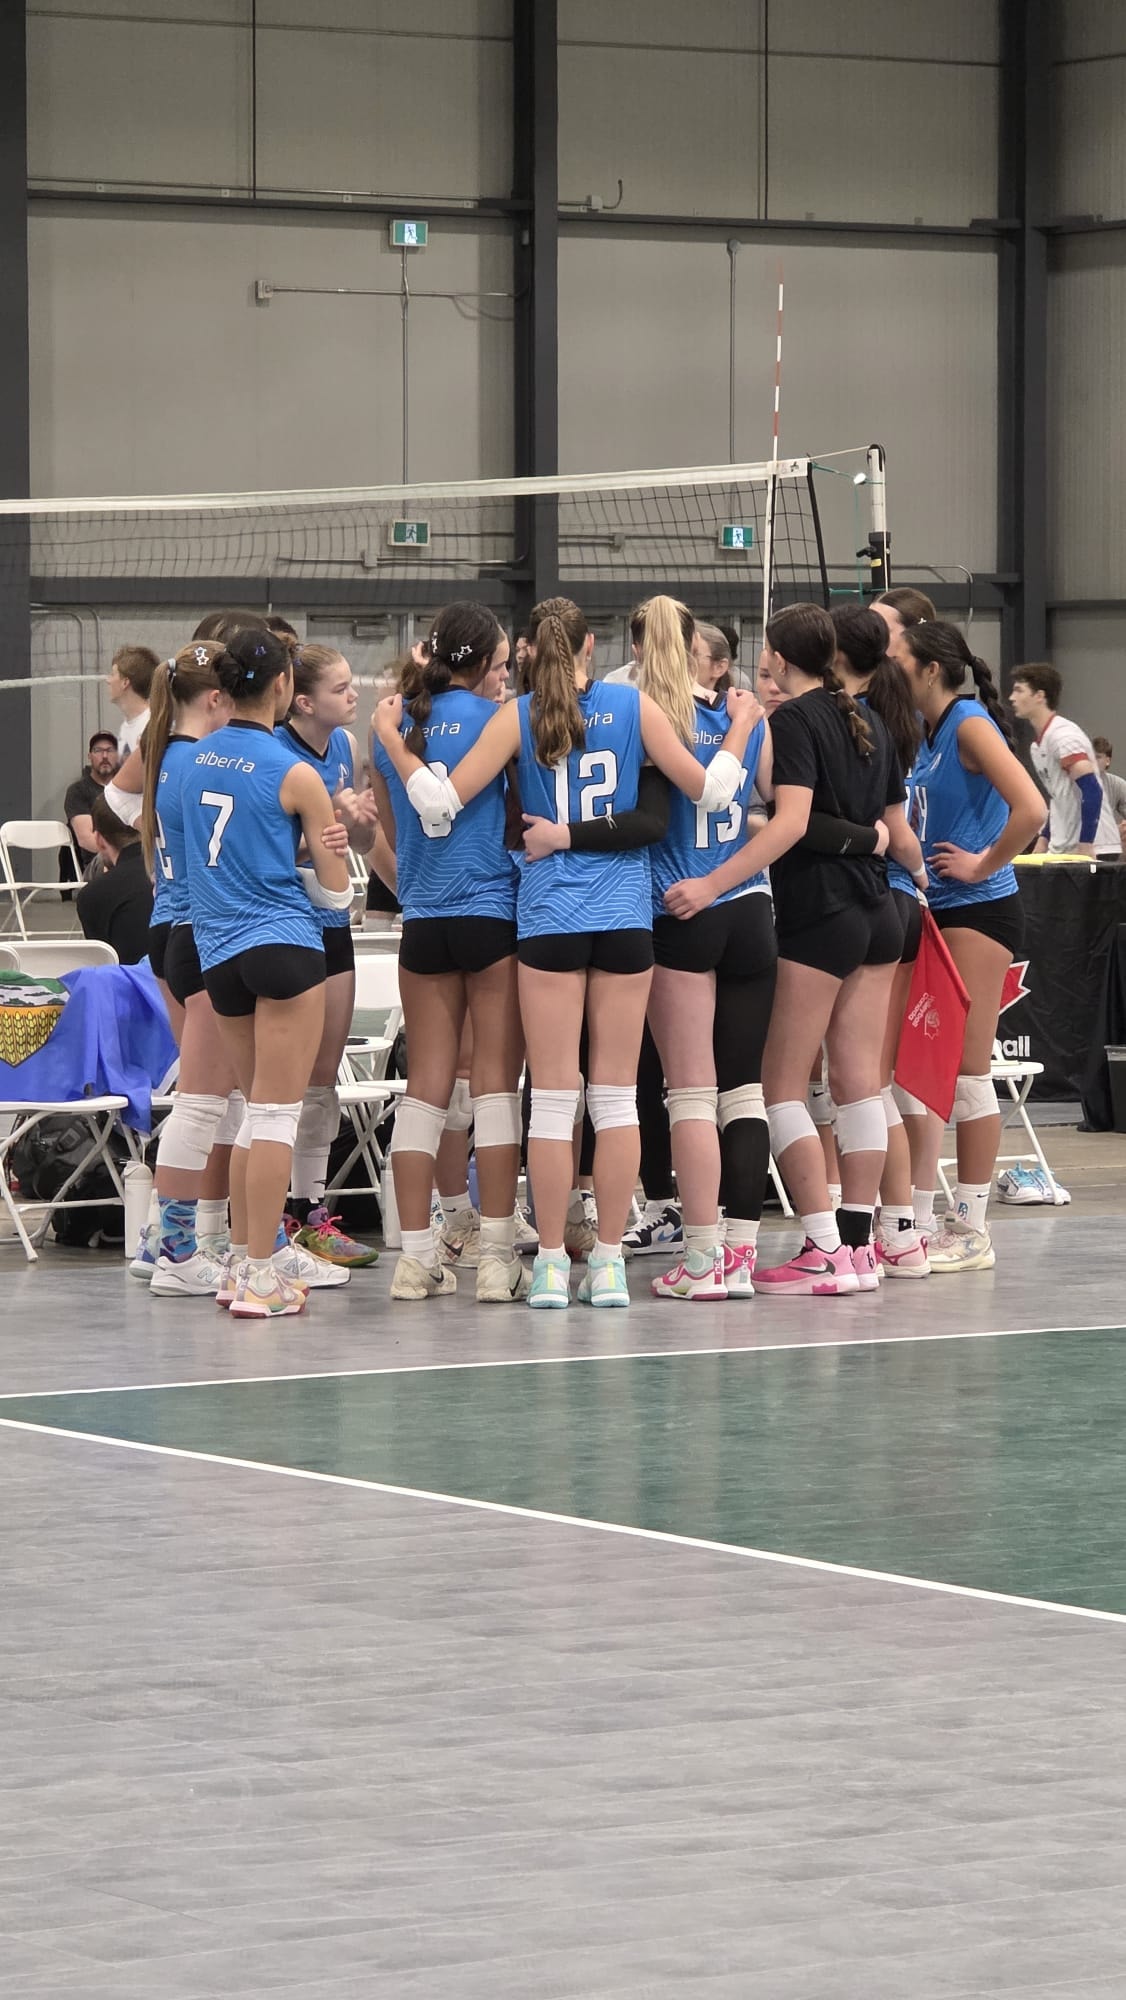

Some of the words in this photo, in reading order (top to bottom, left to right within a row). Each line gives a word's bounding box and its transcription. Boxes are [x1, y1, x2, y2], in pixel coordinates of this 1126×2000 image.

[692, 729, 723, 745] albe
[195, 751, 256, 773] alberta
[550, 749, 618, 824] 12
[199, 789, 235, 868] 7
